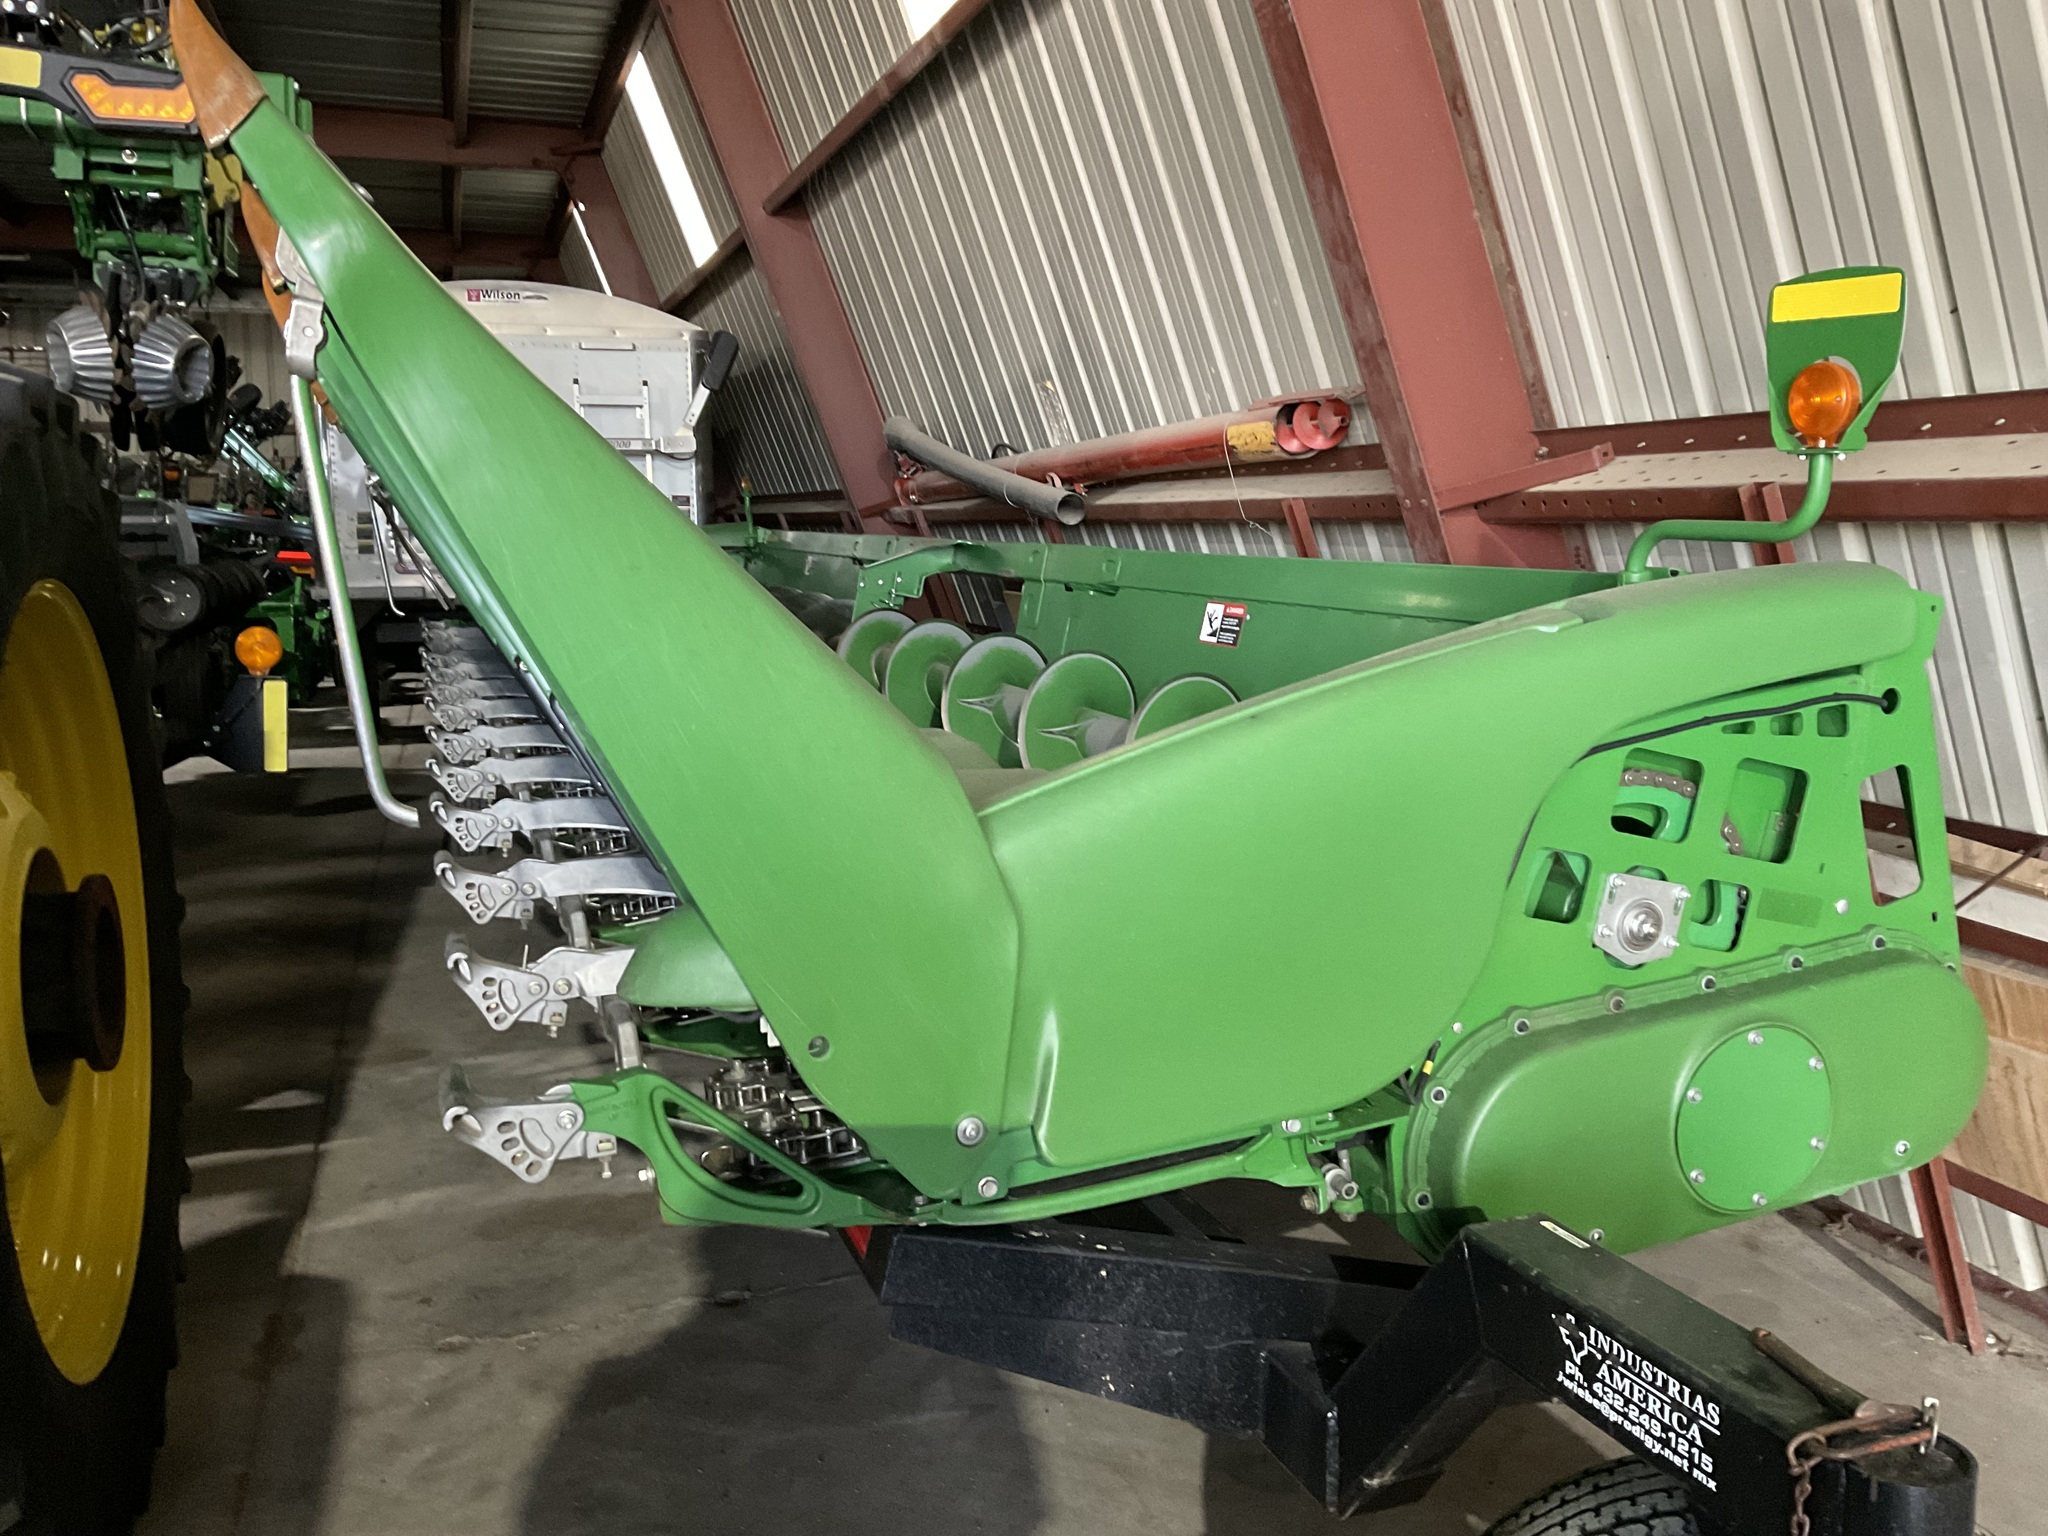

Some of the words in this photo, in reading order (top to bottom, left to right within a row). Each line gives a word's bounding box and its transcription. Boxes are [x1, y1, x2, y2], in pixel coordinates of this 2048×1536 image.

[480, 289, 521, 300] Wilson
[1565, 1360, 1588, 1388] Ph.
[1588, 1325, 1720, 1426] INDUSTRIAS
[1595, 1363, 1704, 1448] AMERICA
